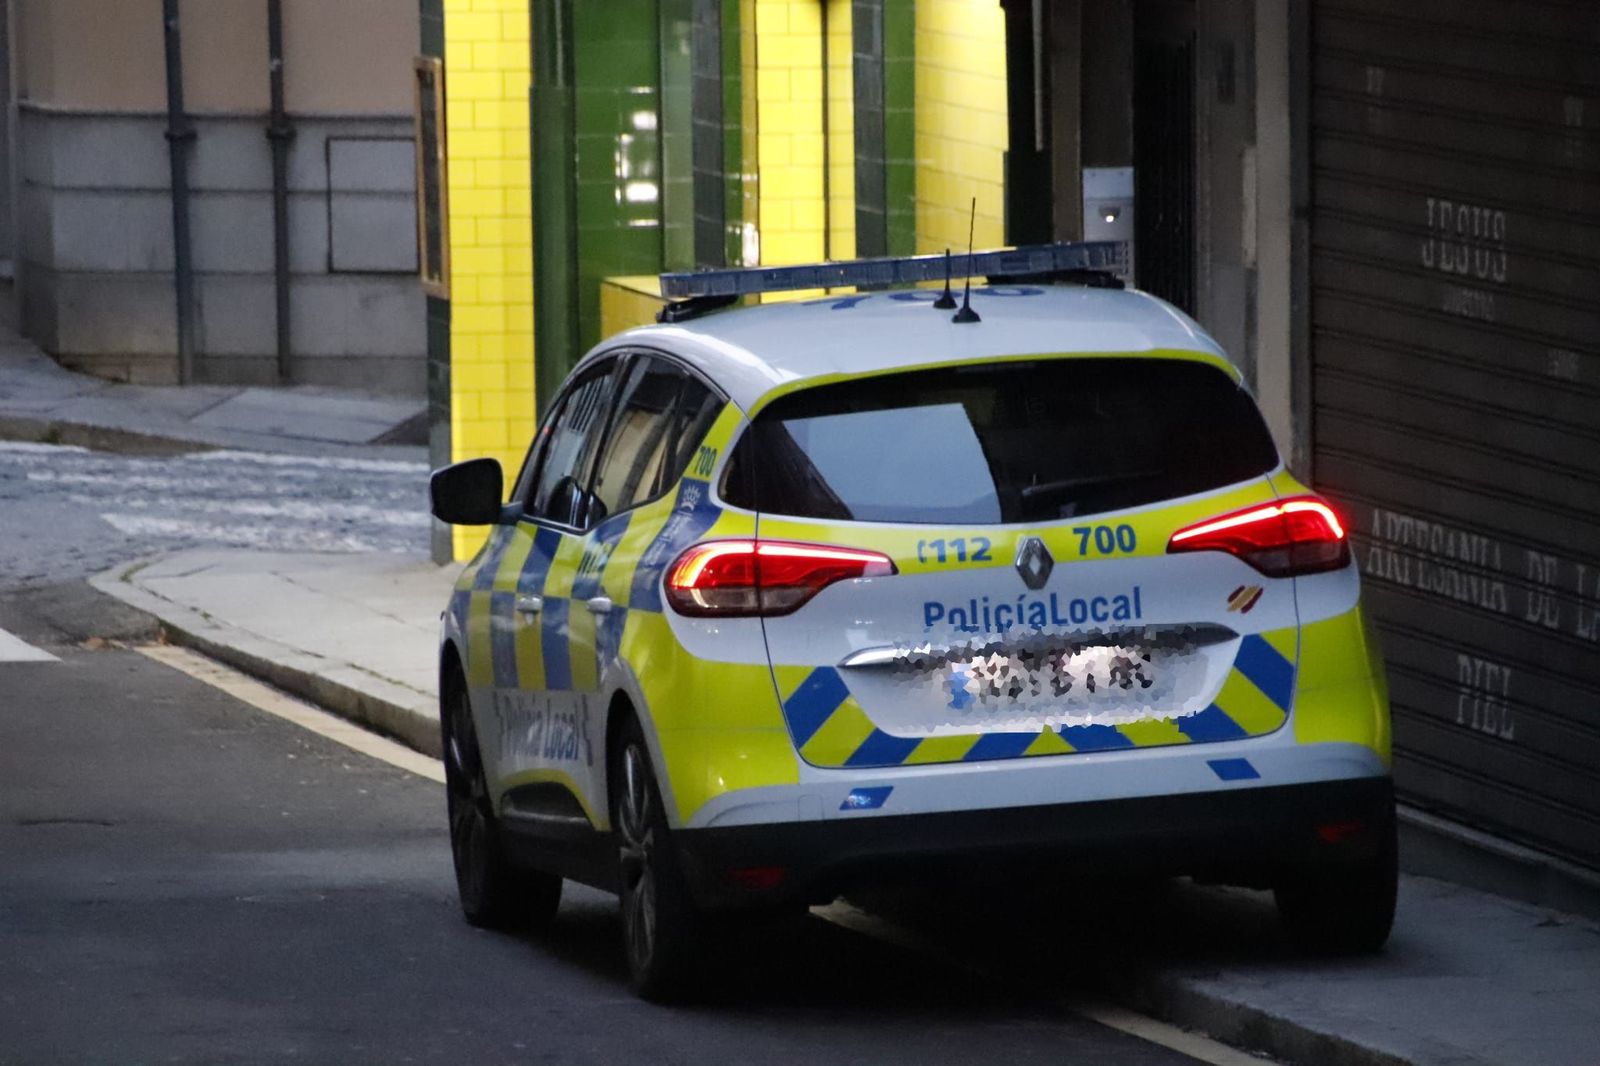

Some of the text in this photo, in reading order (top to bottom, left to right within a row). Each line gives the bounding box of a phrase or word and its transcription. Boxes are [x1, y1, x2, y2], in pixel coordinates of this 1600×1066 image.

[1421, 197, 1506, 283] JESUS
[694, 446, 717, 477] 700
[1073, 524, 1136, 555] 700
[1526, 550, 1559, 629] DE
